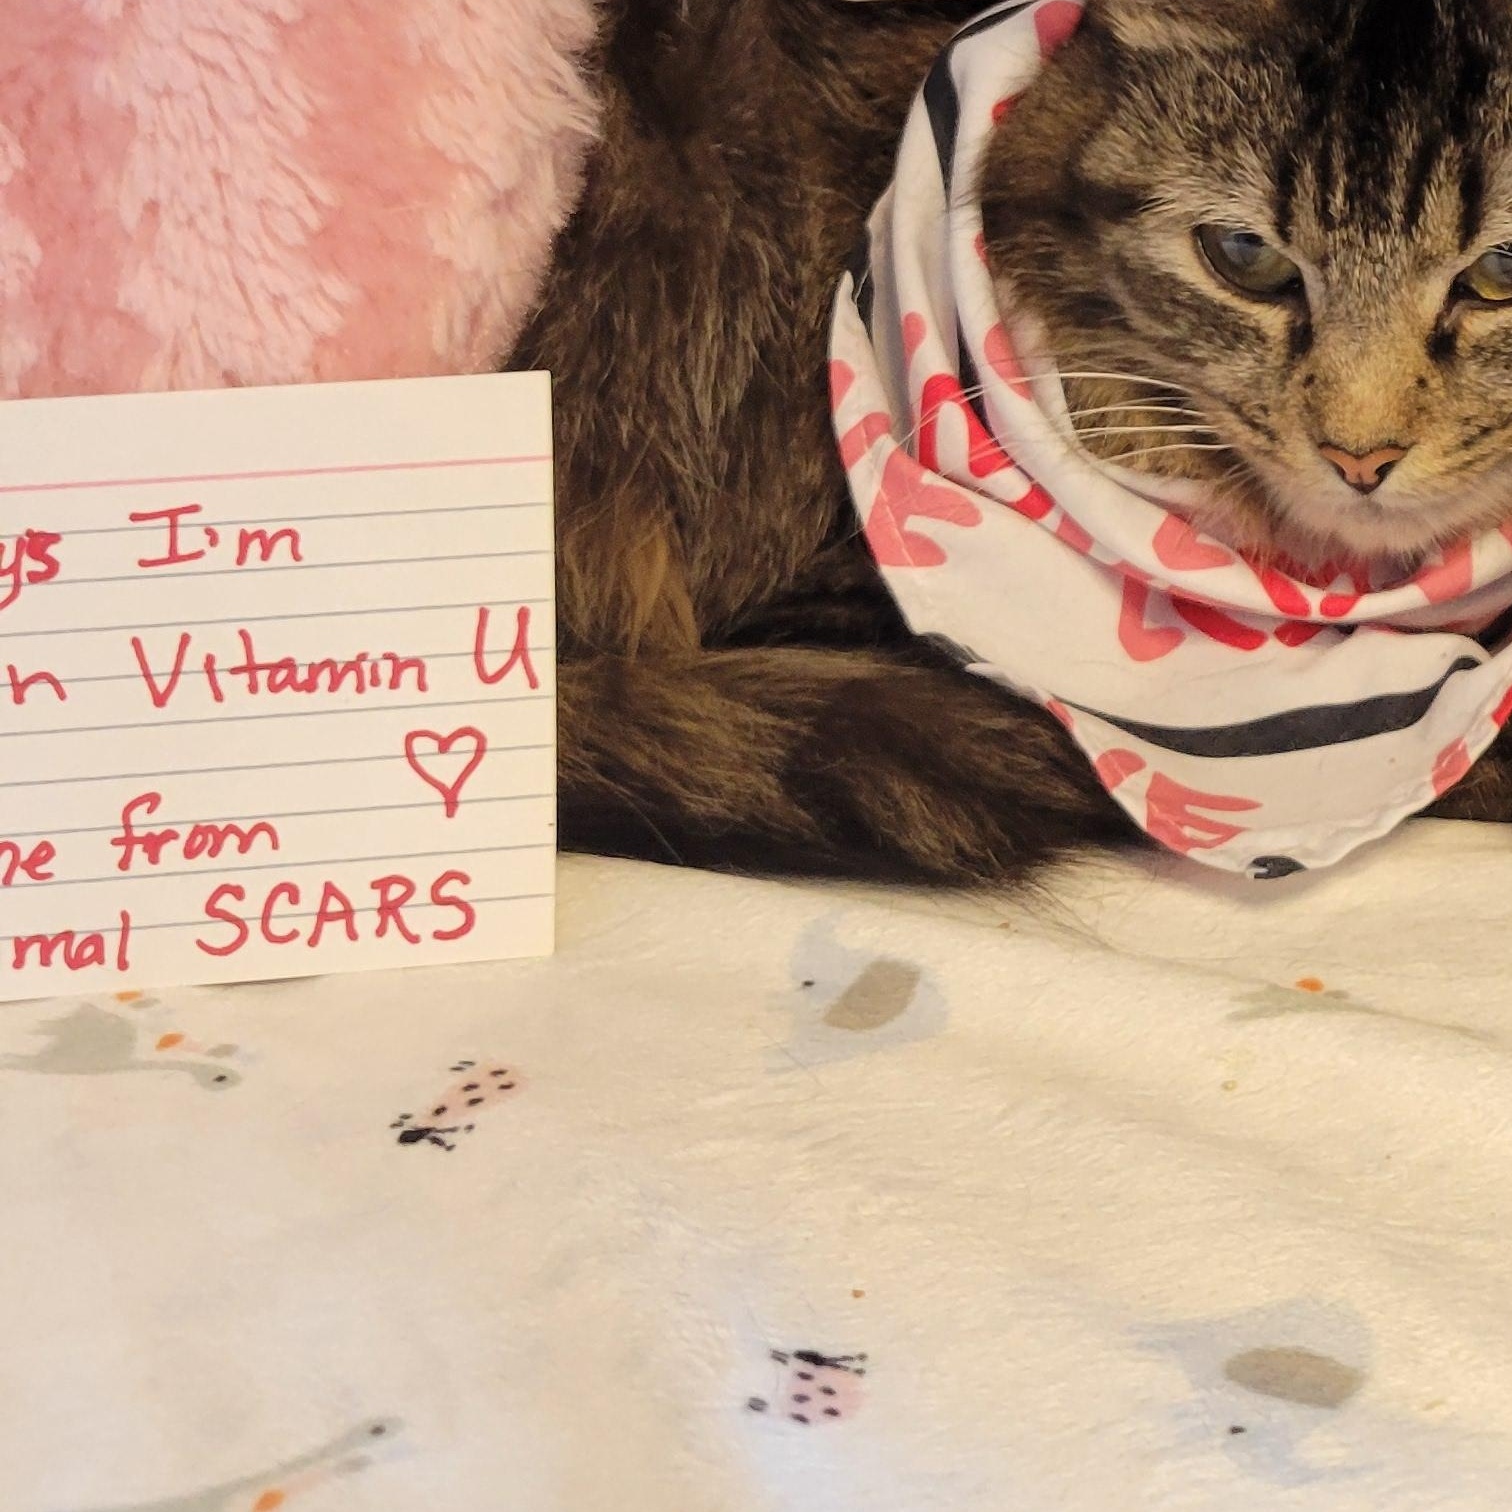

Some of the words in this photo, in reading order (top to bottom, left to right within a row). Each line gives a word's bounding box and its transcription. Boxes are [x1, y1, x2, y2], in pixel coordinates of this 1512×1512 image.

[129, 504, 302, 568] I'm
[131, 628, 427, 709] Vitamin
[473, 606, 539, 690] U
[111, 792, 279, 871] from
[12, 910, 131, 972] mal
[196, 870, 476, 957] SCARS
